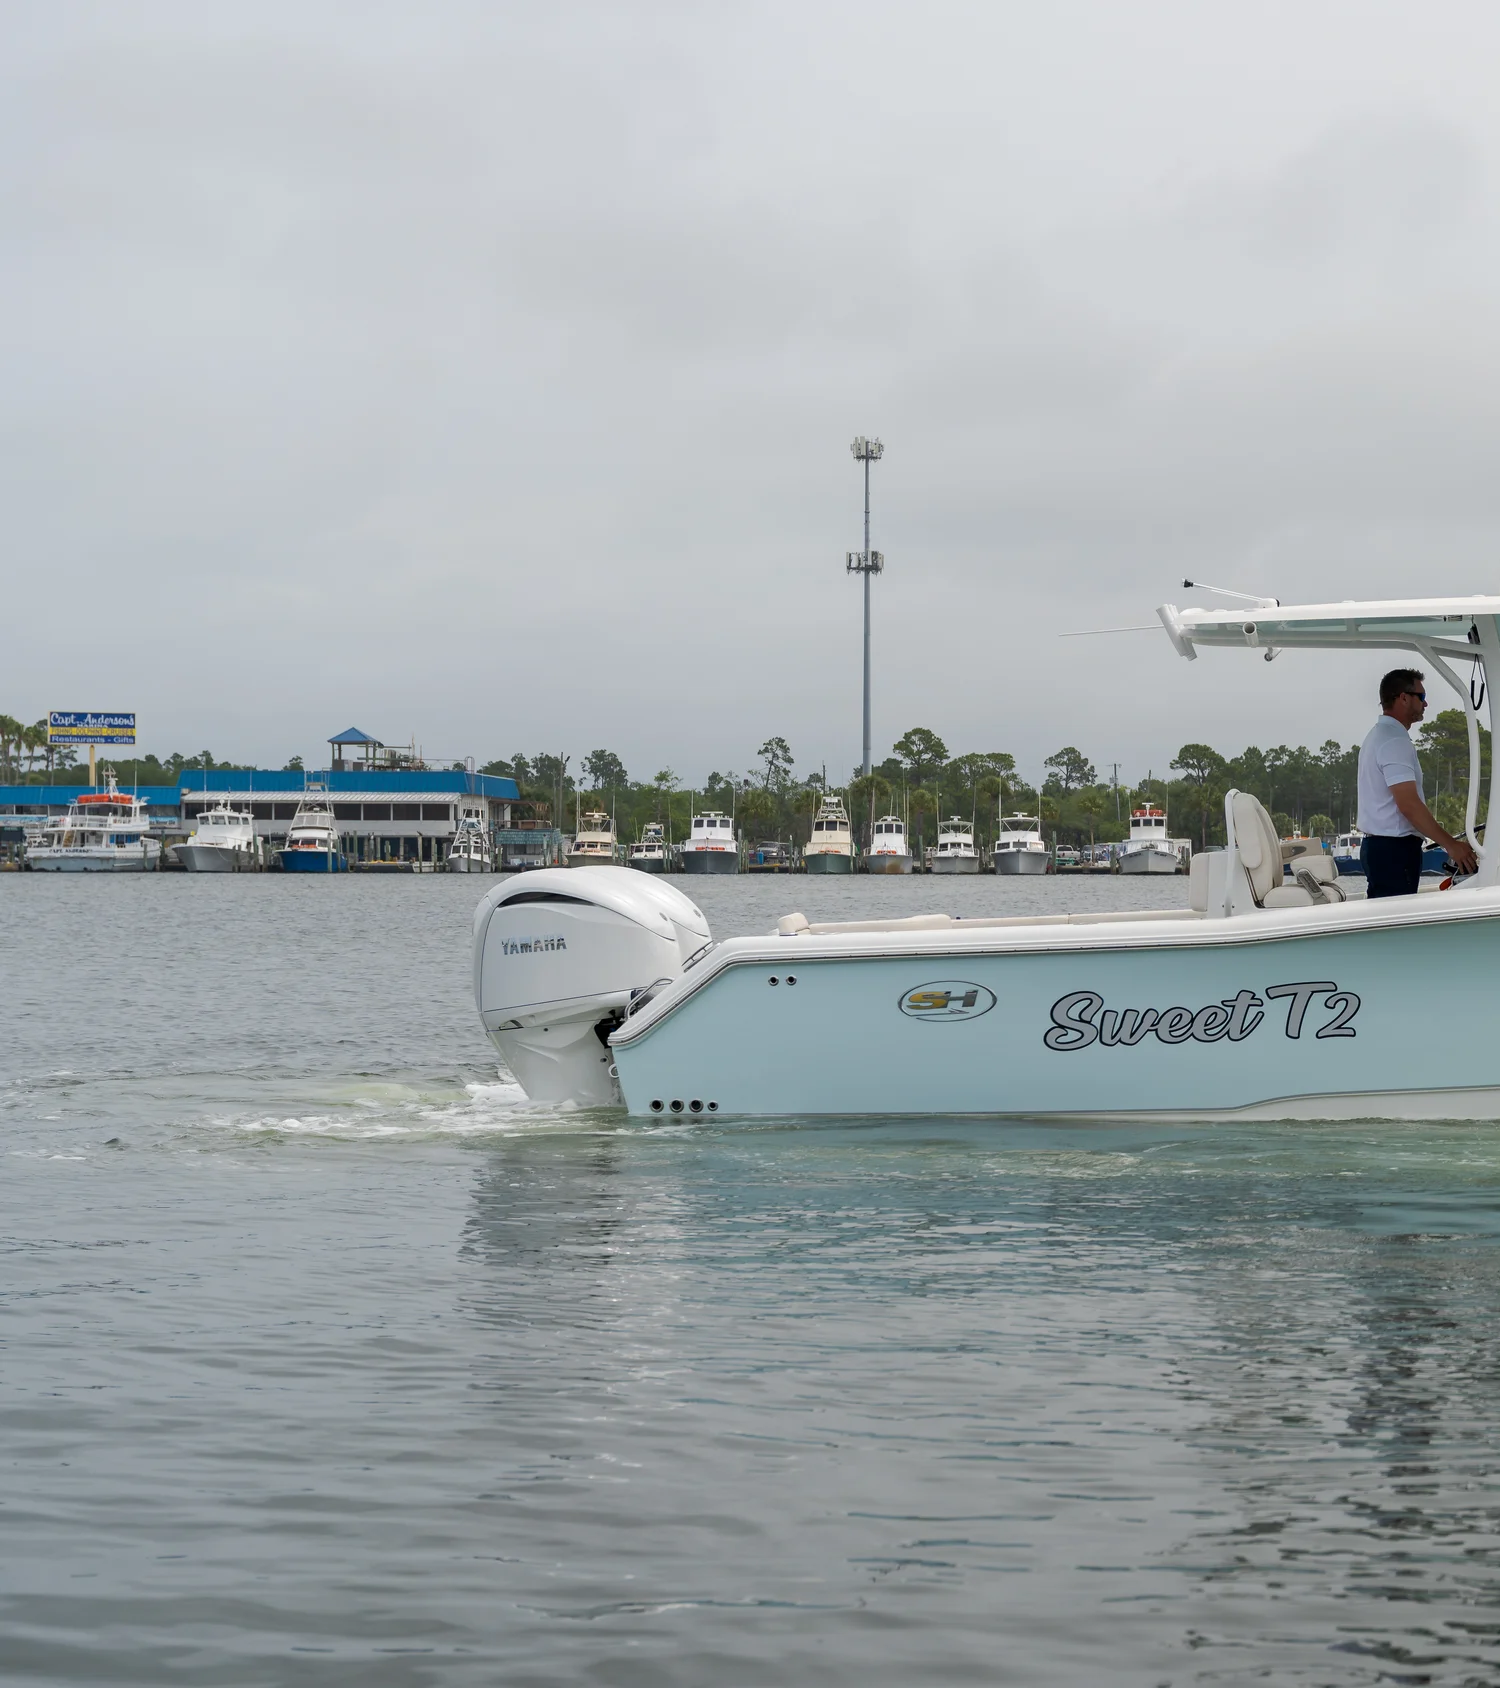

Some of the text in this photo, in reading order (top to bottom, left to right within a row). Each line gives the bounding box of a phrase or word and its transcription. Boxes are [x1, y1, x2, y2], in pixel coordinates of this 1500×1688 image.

[51, 735, 105, 743] Restaurants
[501, 935, 567, 955] YAMAHA
[1043, 981, 1361, 1051] Sweet T2
